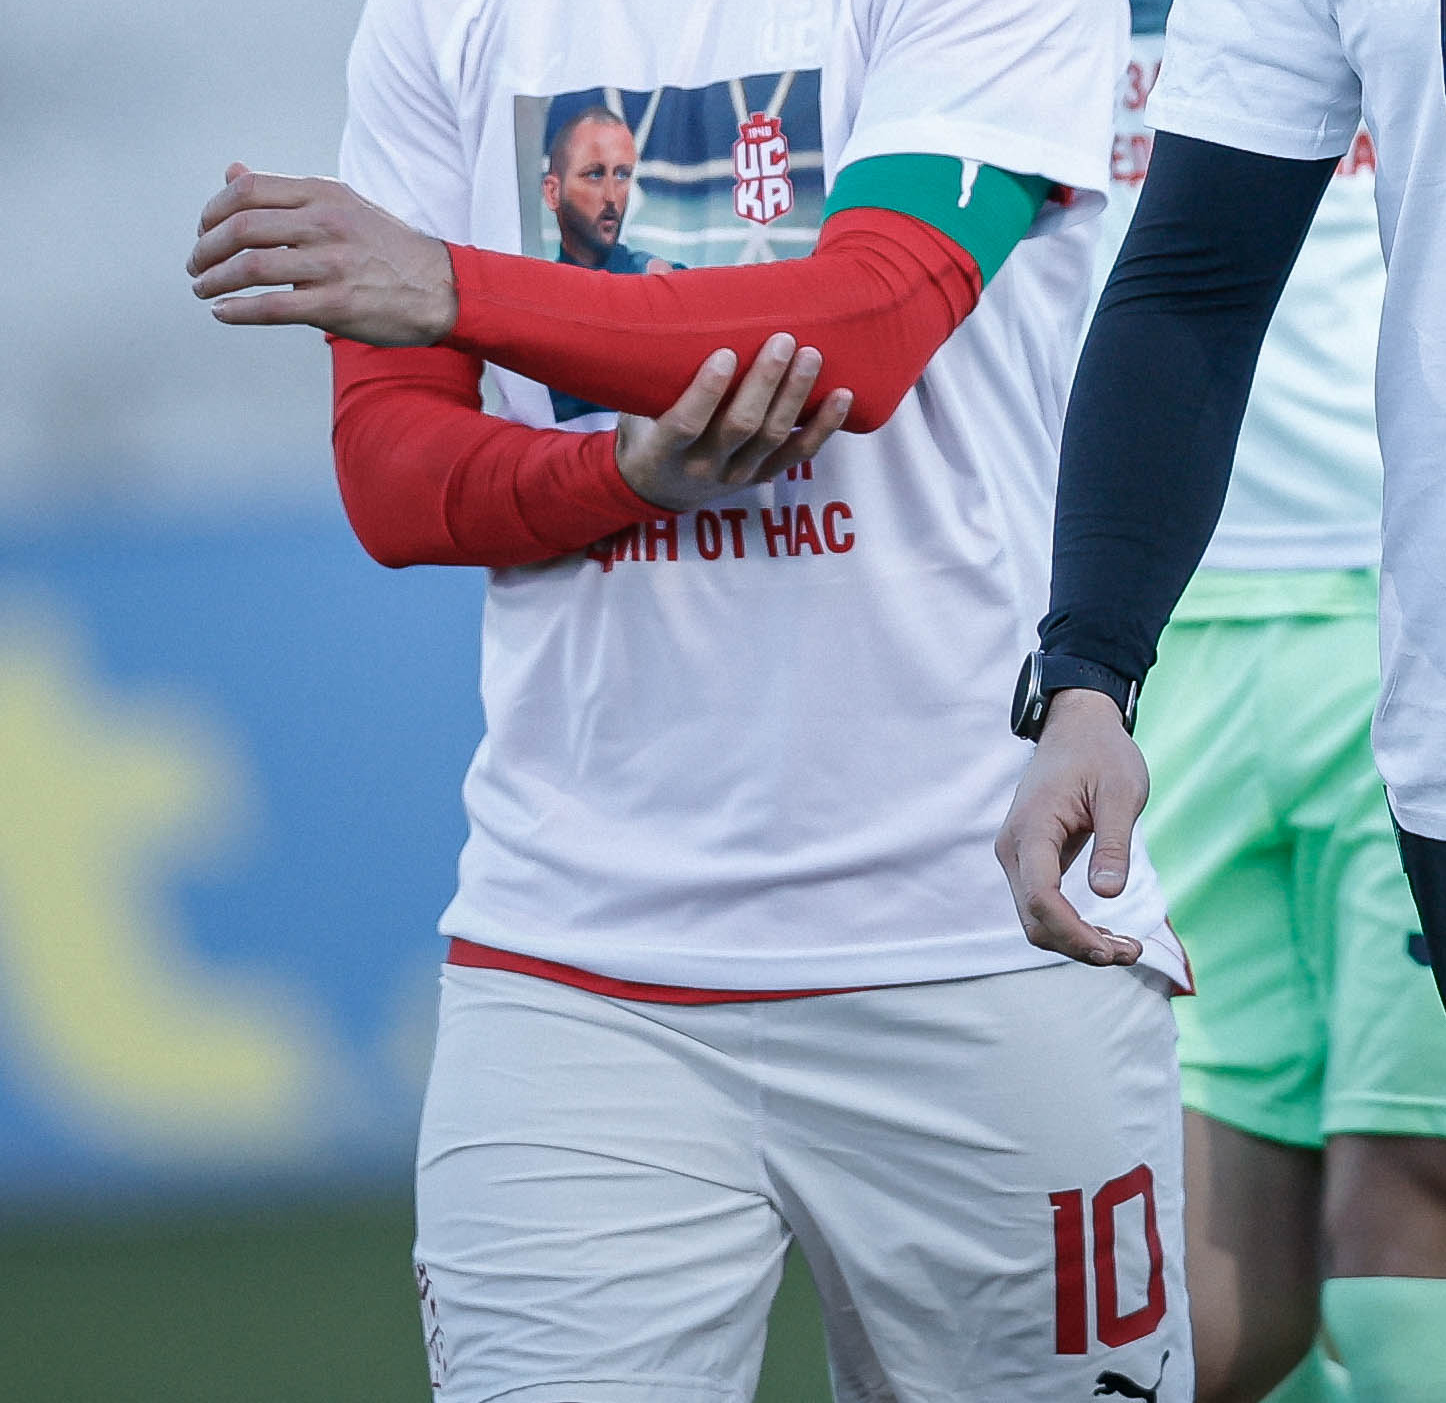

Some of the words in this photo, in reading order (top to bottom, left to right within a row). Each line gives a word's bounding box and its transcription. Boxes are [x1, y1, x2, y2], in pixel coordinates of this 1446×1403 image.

[695, 507, 748, 561] ОТ
[760, 501, 856, 558] НАС
[1048, 1163, 1167, 1355] 10
